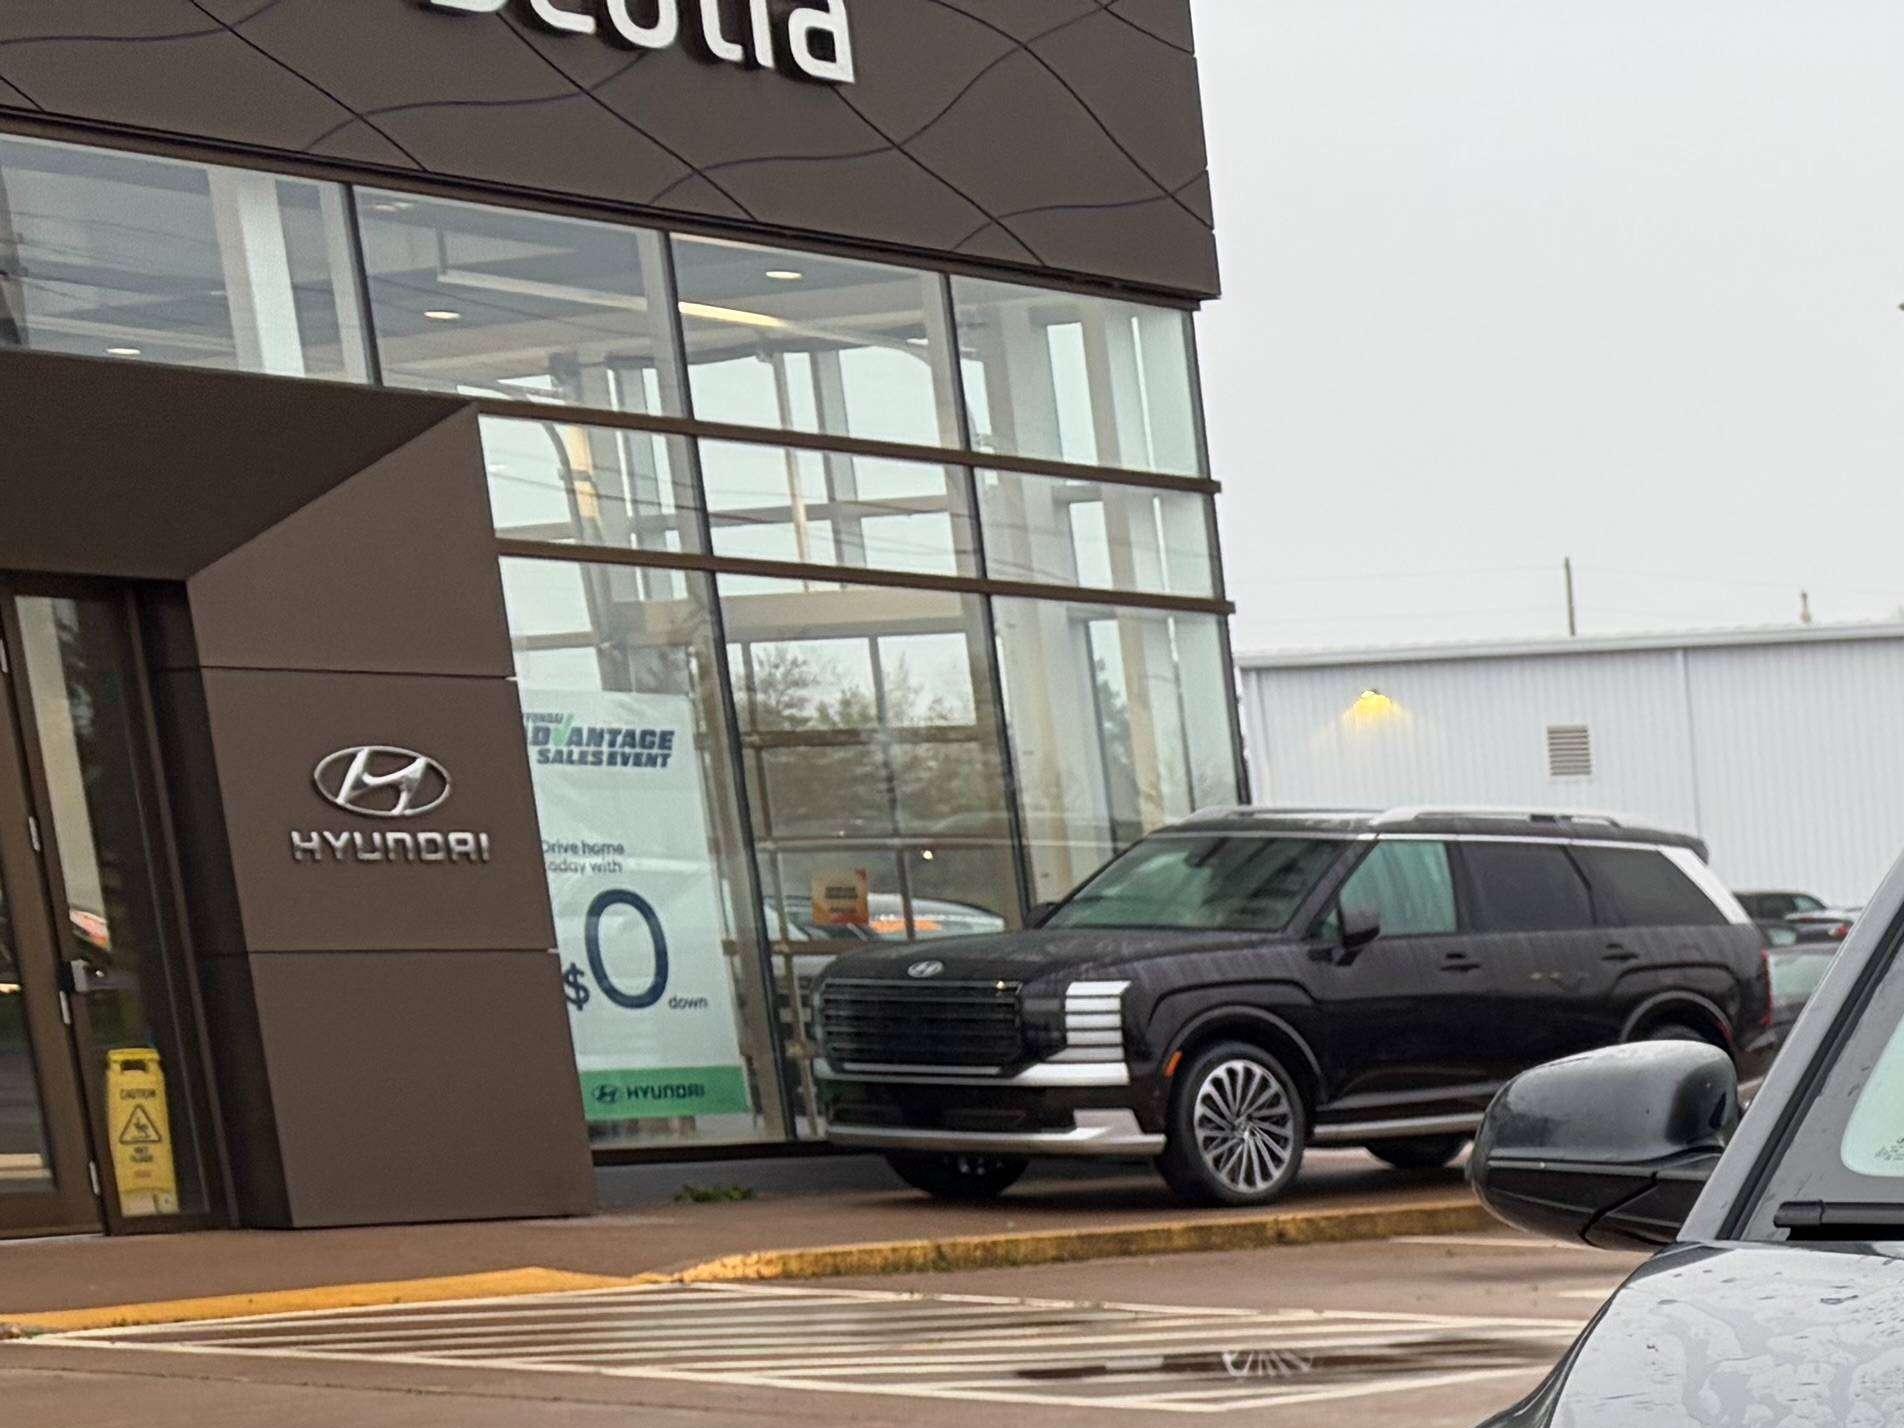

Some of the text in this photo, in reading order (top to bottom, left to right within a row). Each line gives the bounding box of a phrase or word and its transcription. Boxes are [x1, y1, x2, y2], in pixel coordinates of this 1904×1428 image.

[536, 748, 672, 768] SALES EVENT
[290, 830, 490, 861] HYUNDAI
[581, 840, 625, 855] home
[548, 859, 586, 876] oday
[668, 996, 708, 1009] down
[625, 1083, 705, 1100] HYUNDAI
